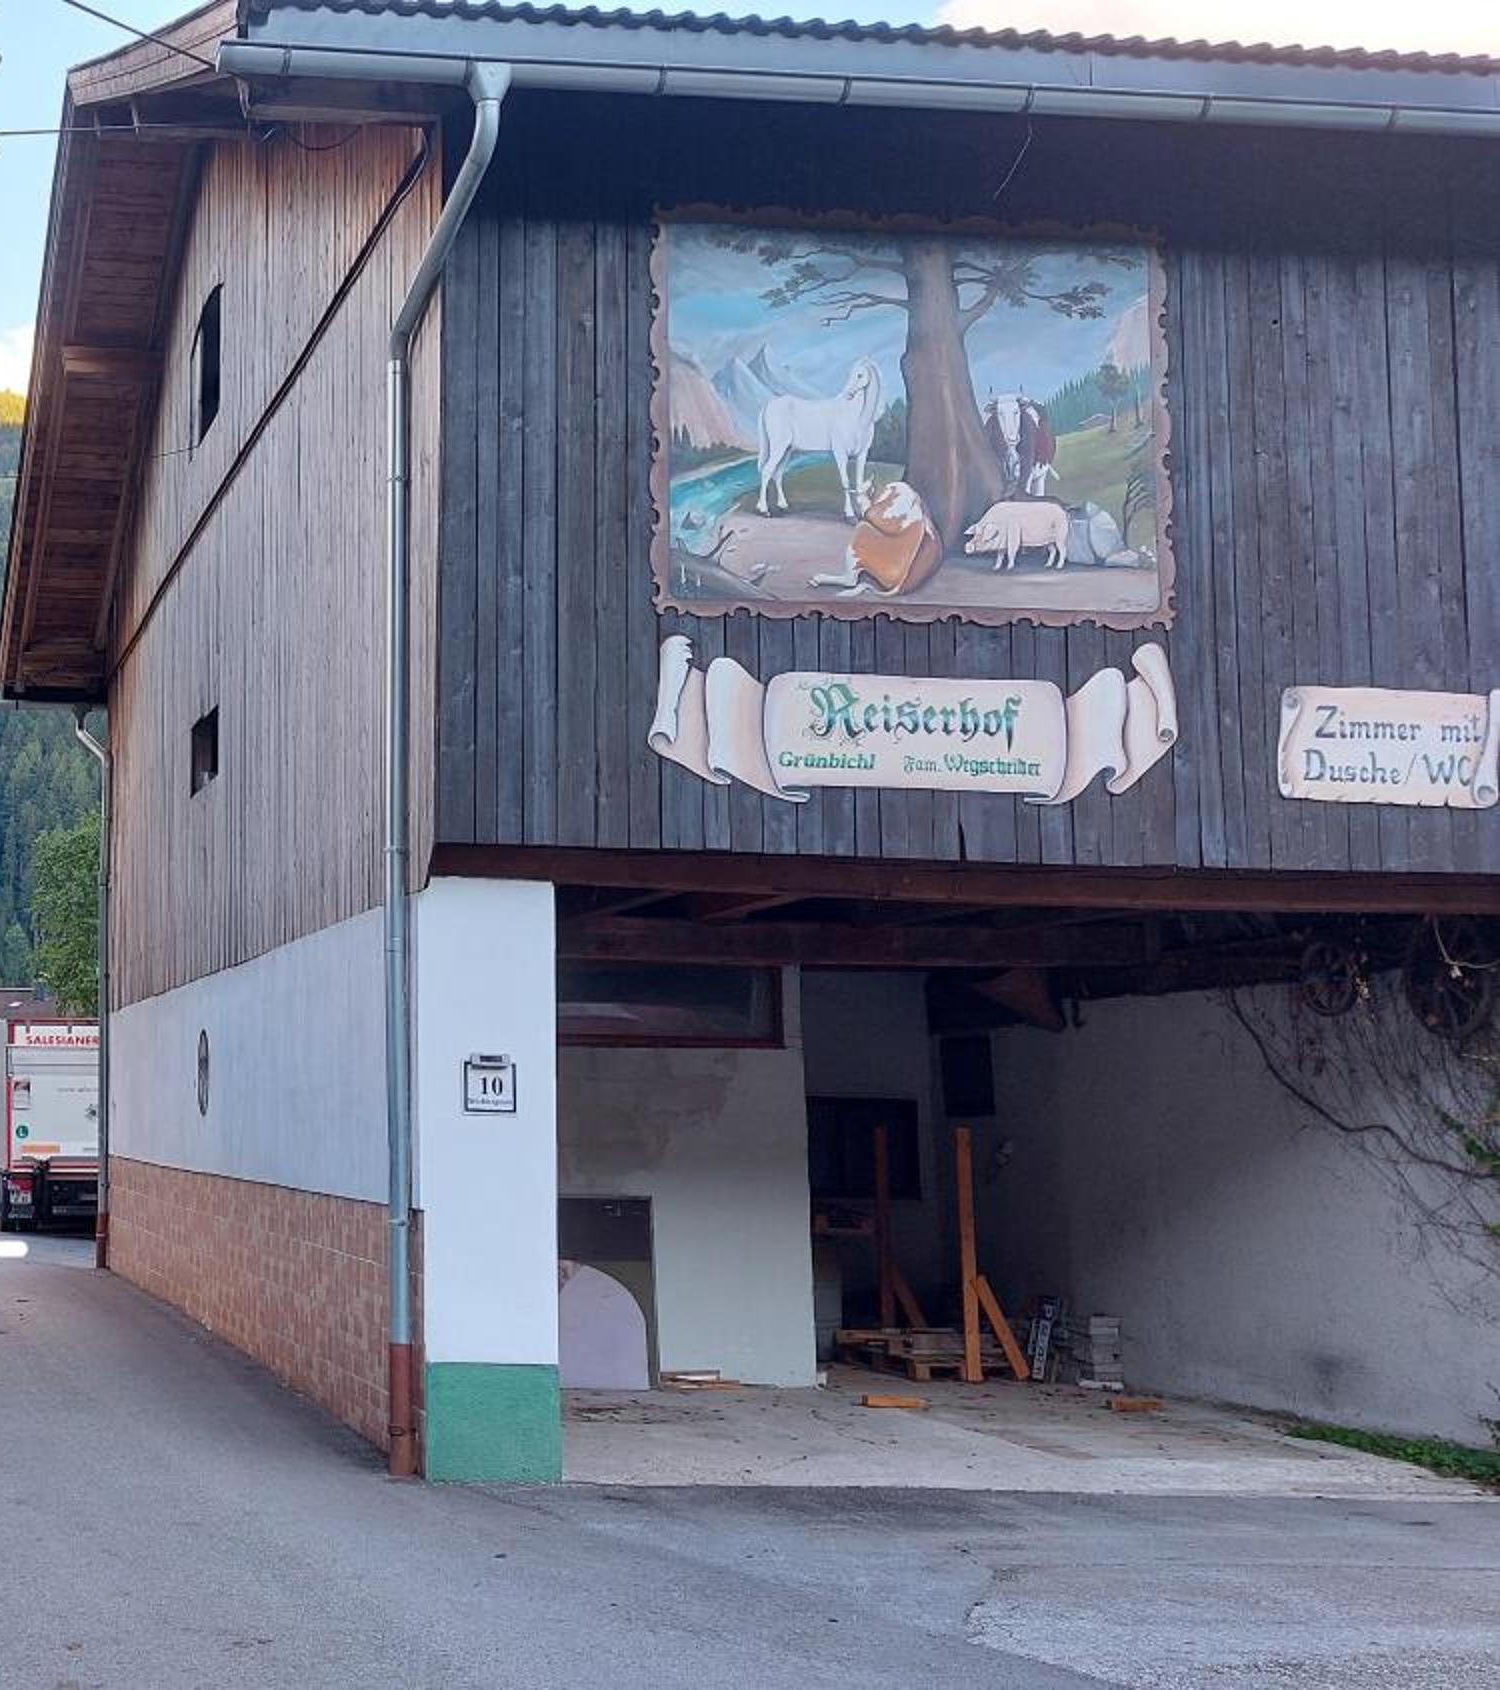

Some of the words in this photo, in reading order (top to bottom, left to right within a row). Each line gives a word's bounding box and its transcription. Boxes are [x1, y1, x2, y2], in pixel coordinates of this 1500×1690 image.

[1315, 705, 1421, 740] Zimmer
[1441, 714, 1482, 743] mit
[778, 751, 876, 770] Grünbichl
[903, 754, 942, 773] Fam.
[943, 753, 1041, 777] Wegscheider
[481, 1076, 503, 1096] 10
